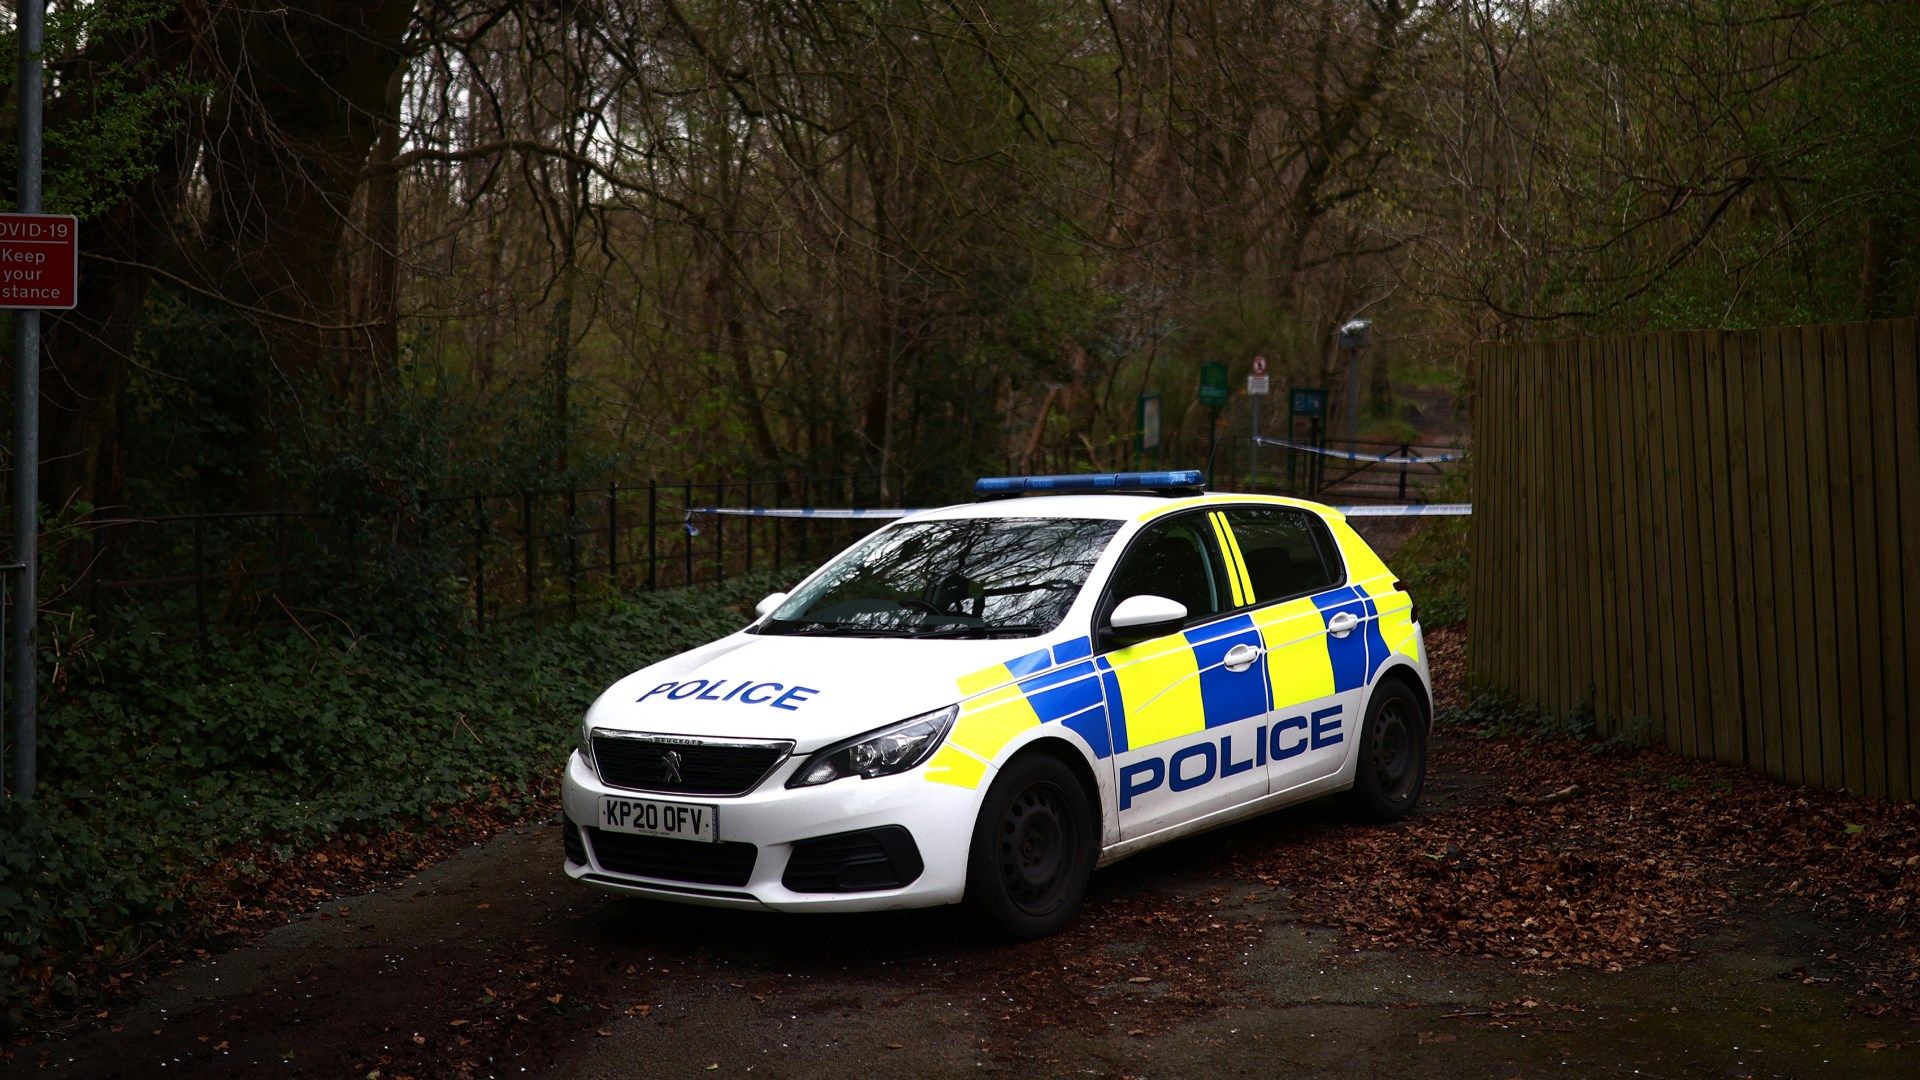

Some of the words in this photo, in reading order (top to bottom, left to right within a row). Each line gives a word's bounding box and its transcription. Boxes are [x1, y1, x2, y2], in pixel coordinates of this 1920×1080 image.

[2, 248, 45, 265] Keep
[3, 269, 42, 282] your
[635, 679, 821, 711] POLICE
[1119, 704, 1344, 811] POLICE
[606, 799, 658, 830] KP20
[663, 805, 703, 835] OFV
